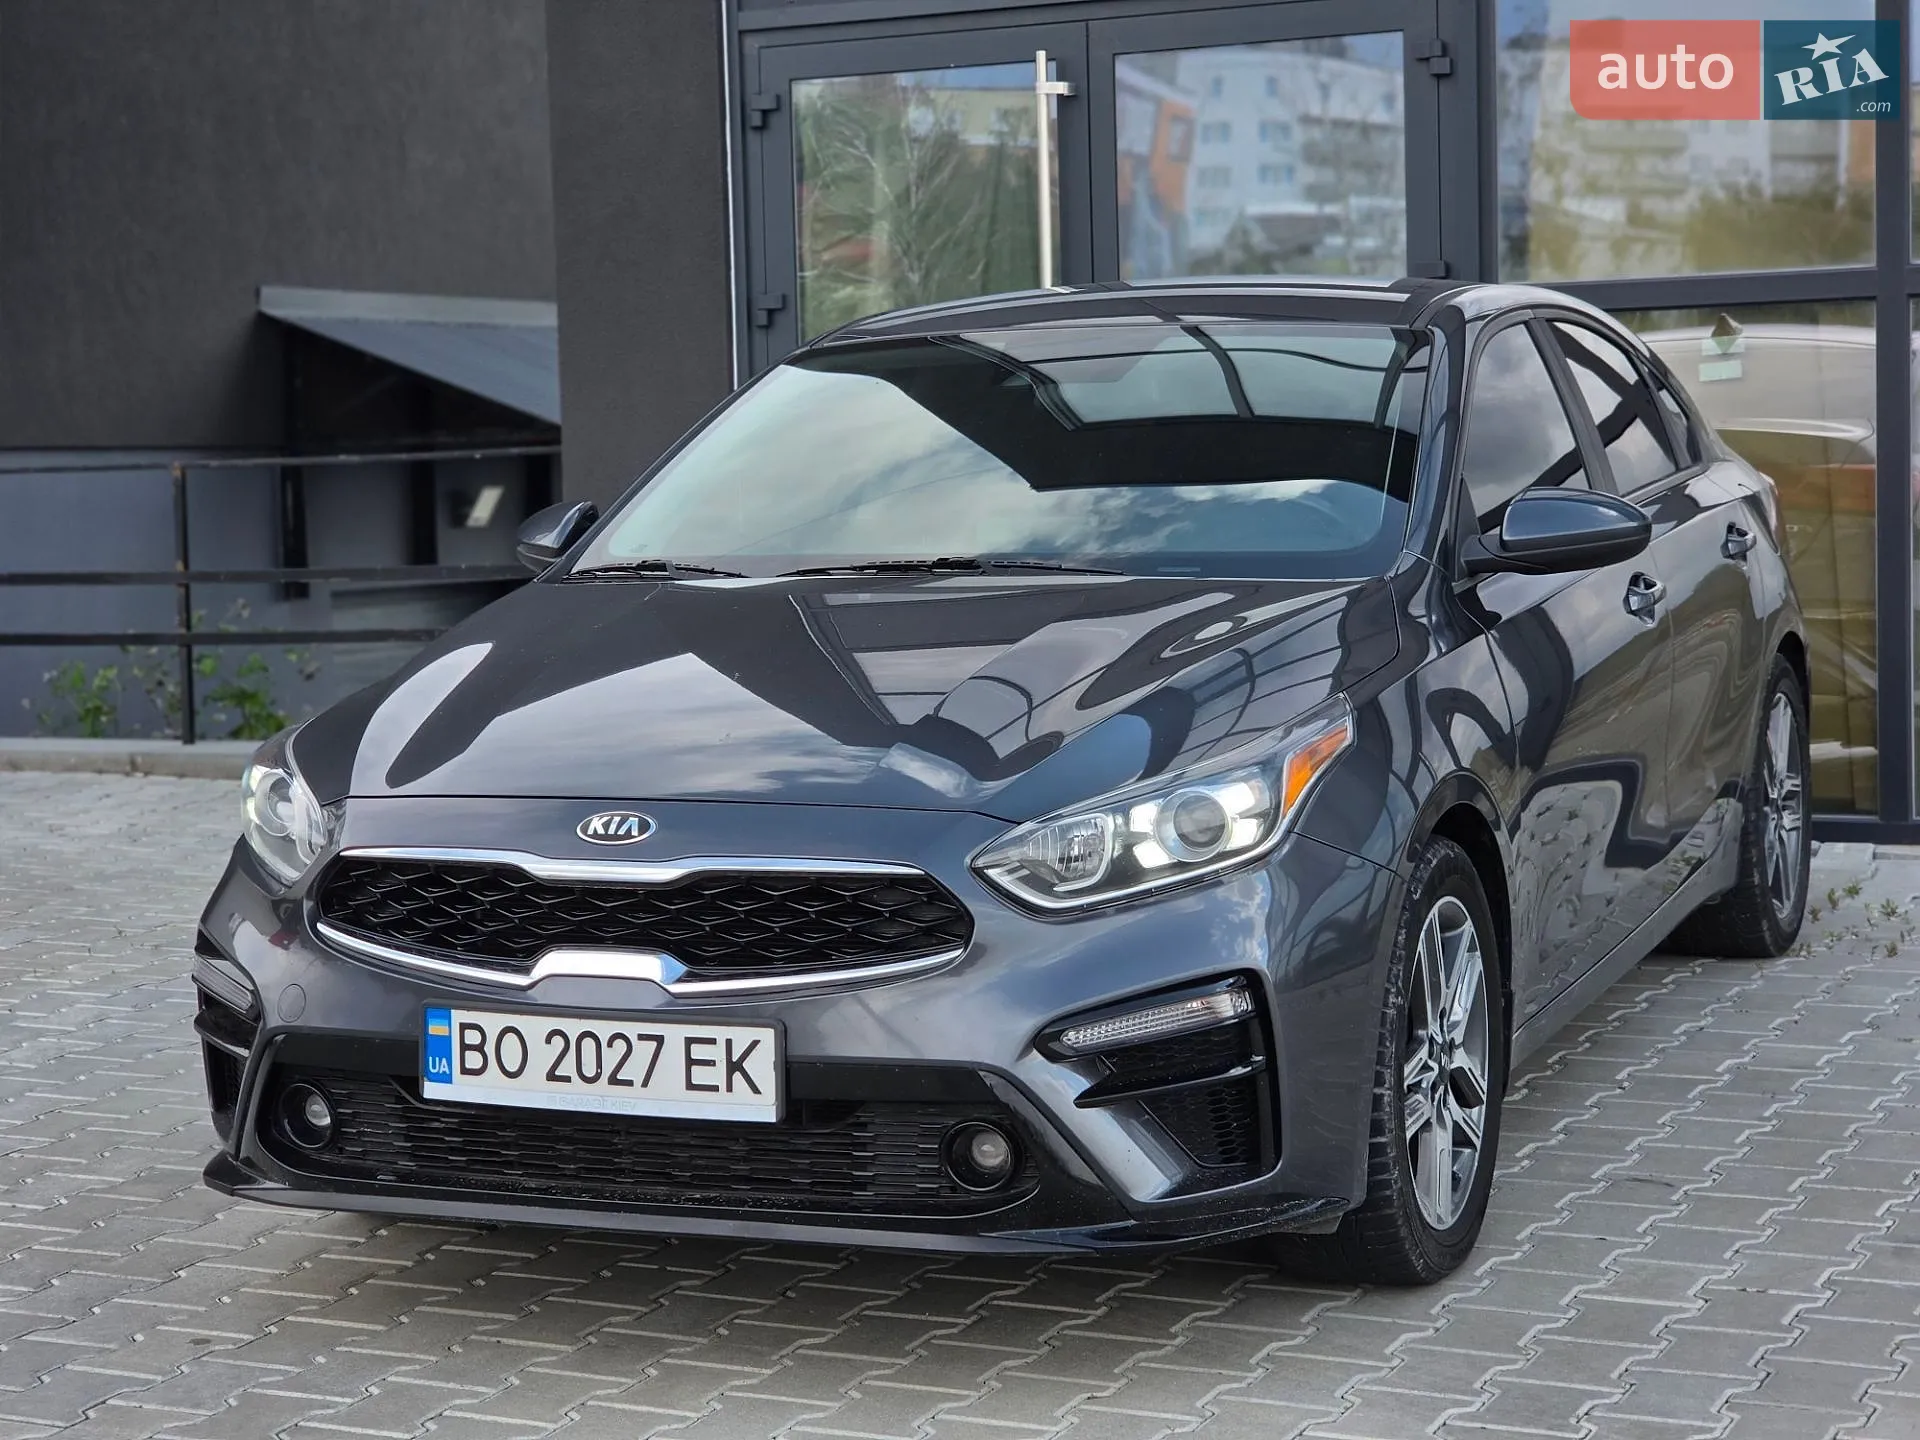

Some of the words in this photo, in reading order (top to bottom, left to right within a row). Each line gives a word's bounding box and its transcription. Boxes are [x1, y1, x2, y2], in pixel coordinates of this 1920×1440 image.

[587, 816, 639, 837] KIA
[428, 1056, 450, 1075] UA
[458, 1022, 529, 1079] BO
[544, 1028, 665, 1089] 2027
[684, 1036, 762, 1095] EK
